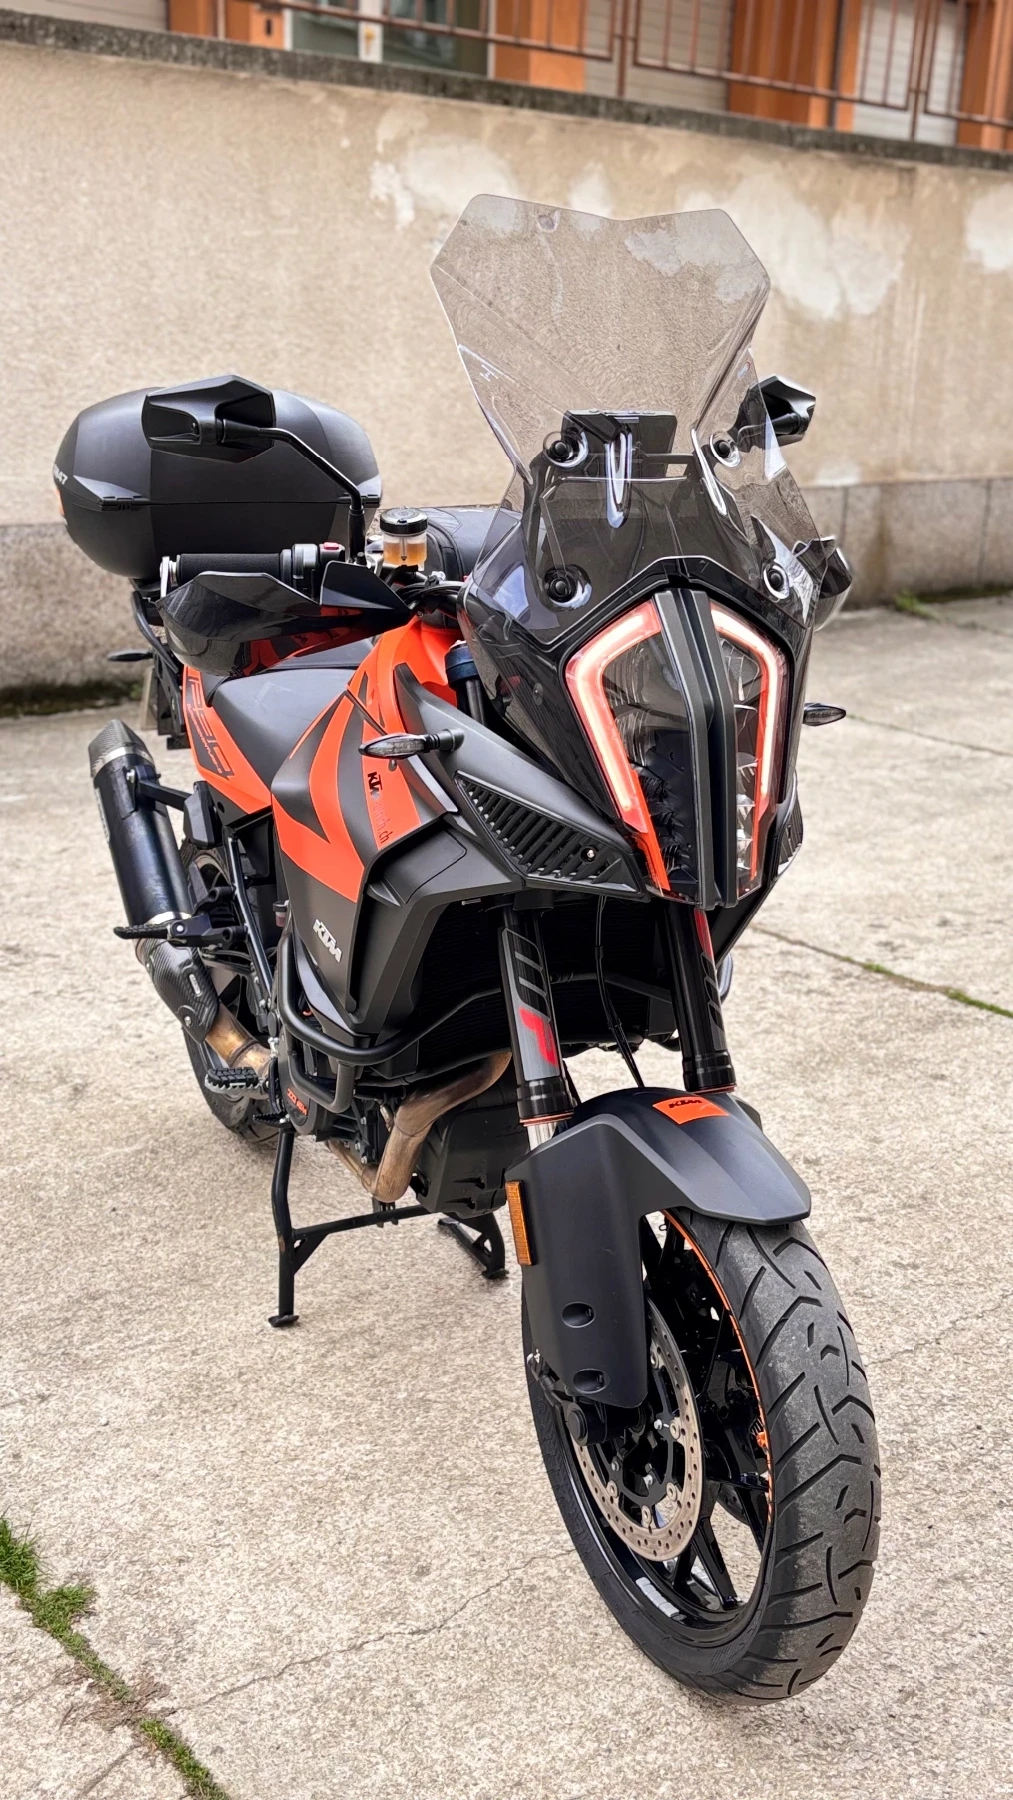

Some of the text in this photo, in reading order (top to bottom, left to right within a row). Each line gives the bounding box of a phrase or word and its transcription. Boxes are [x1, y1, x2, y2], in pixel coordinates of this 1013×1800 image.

[367, 771, 383, 801] KTM
[312, 918, 342, 963] KTM
[668, 1099, 703, 1109] KTM
